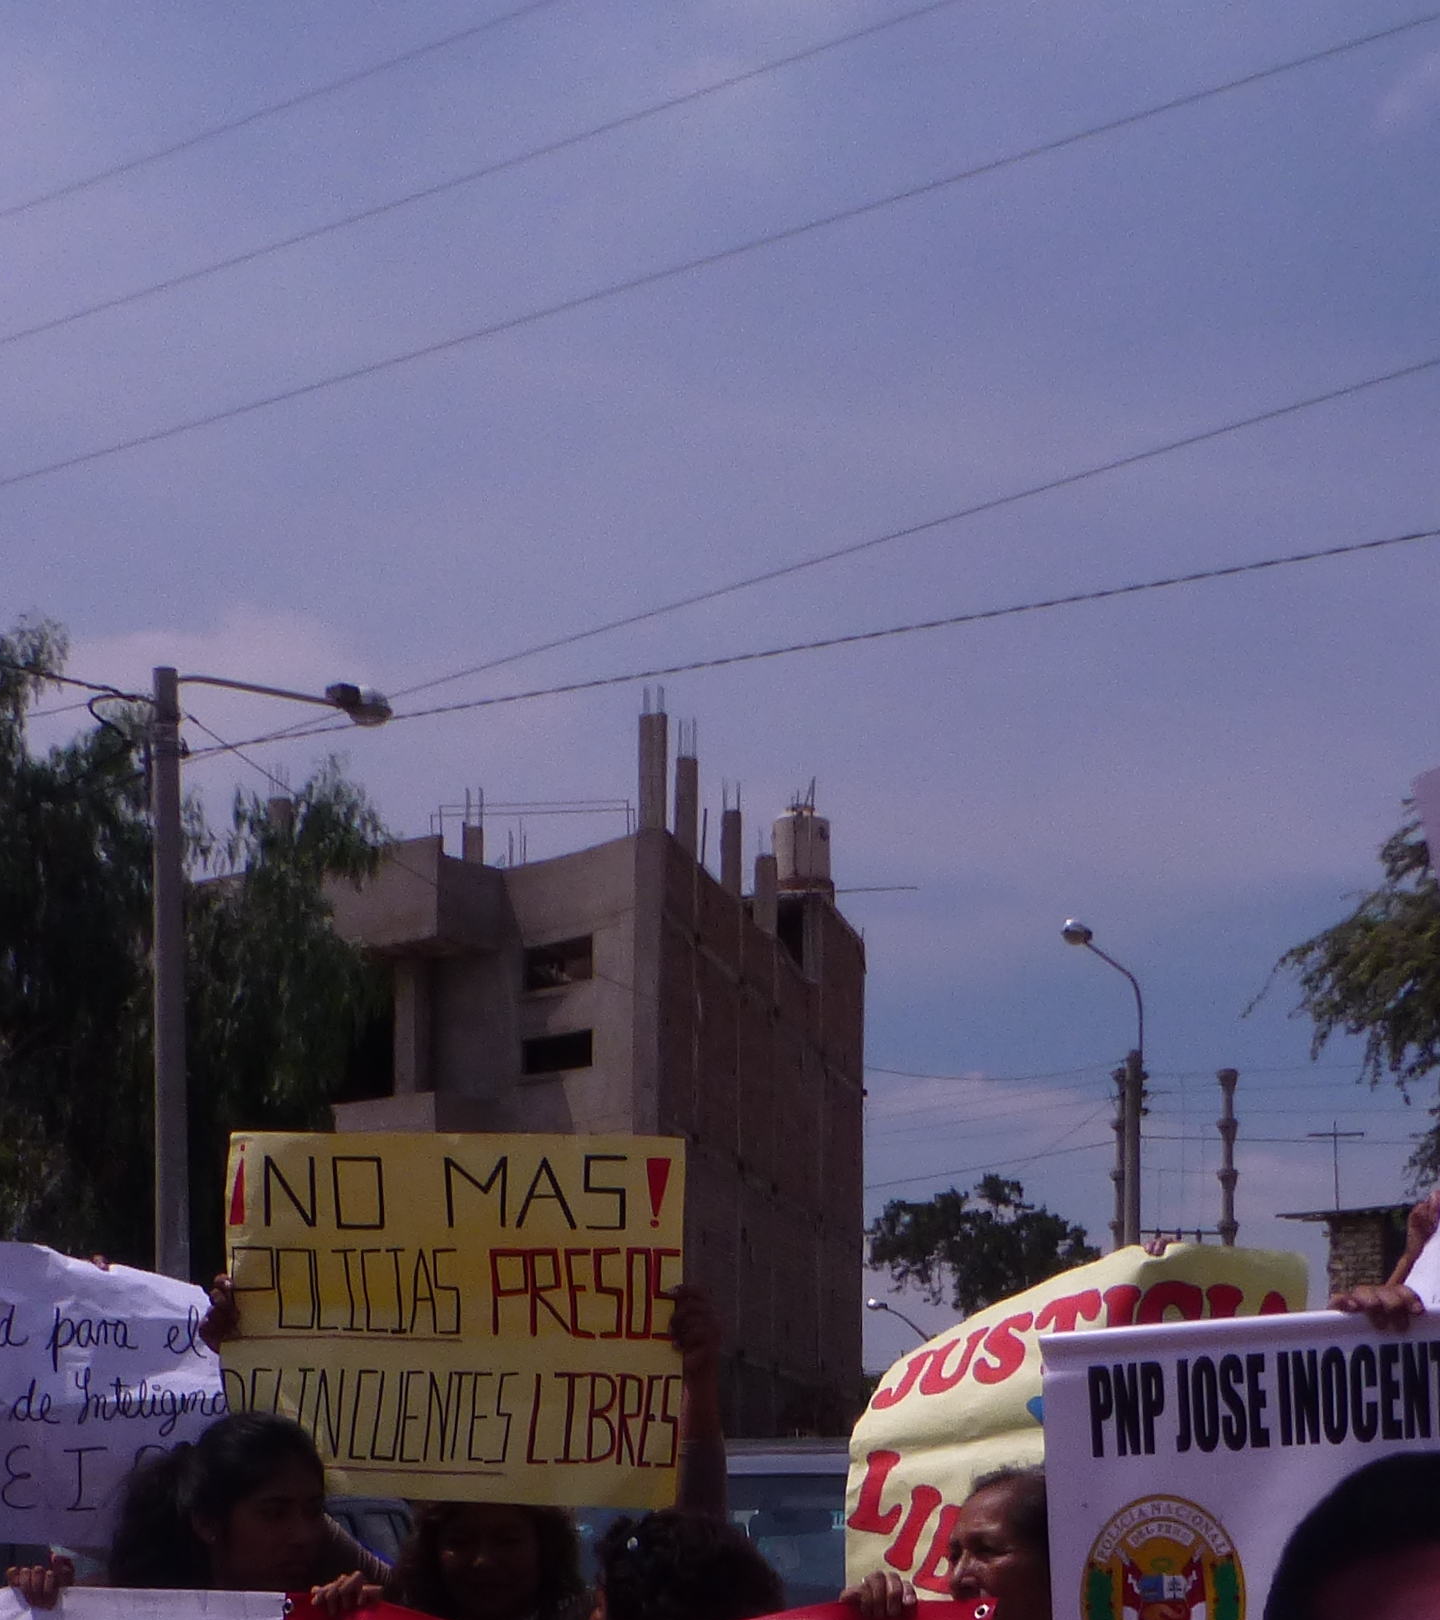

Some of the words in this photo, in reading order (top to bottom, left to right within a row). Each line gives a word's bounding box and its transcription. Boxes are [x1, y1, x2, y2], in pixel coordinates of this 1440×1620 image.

[443, 1155, 672, 1230] MAS!
[231, 1246, 460, 1335] POLICIAS
[488, 1247, 681, 1341] PRESOS
[45, 1305, 139, 1371] para
[163, 1304, 207, 1359] el
[8, 1379, 61, 1424] de
[526, 1372, 683, 1469] LIBRES
[1087, 1360, 1165, 1458] PNP
[1175, 1352, 1271, 1453] JOSE
